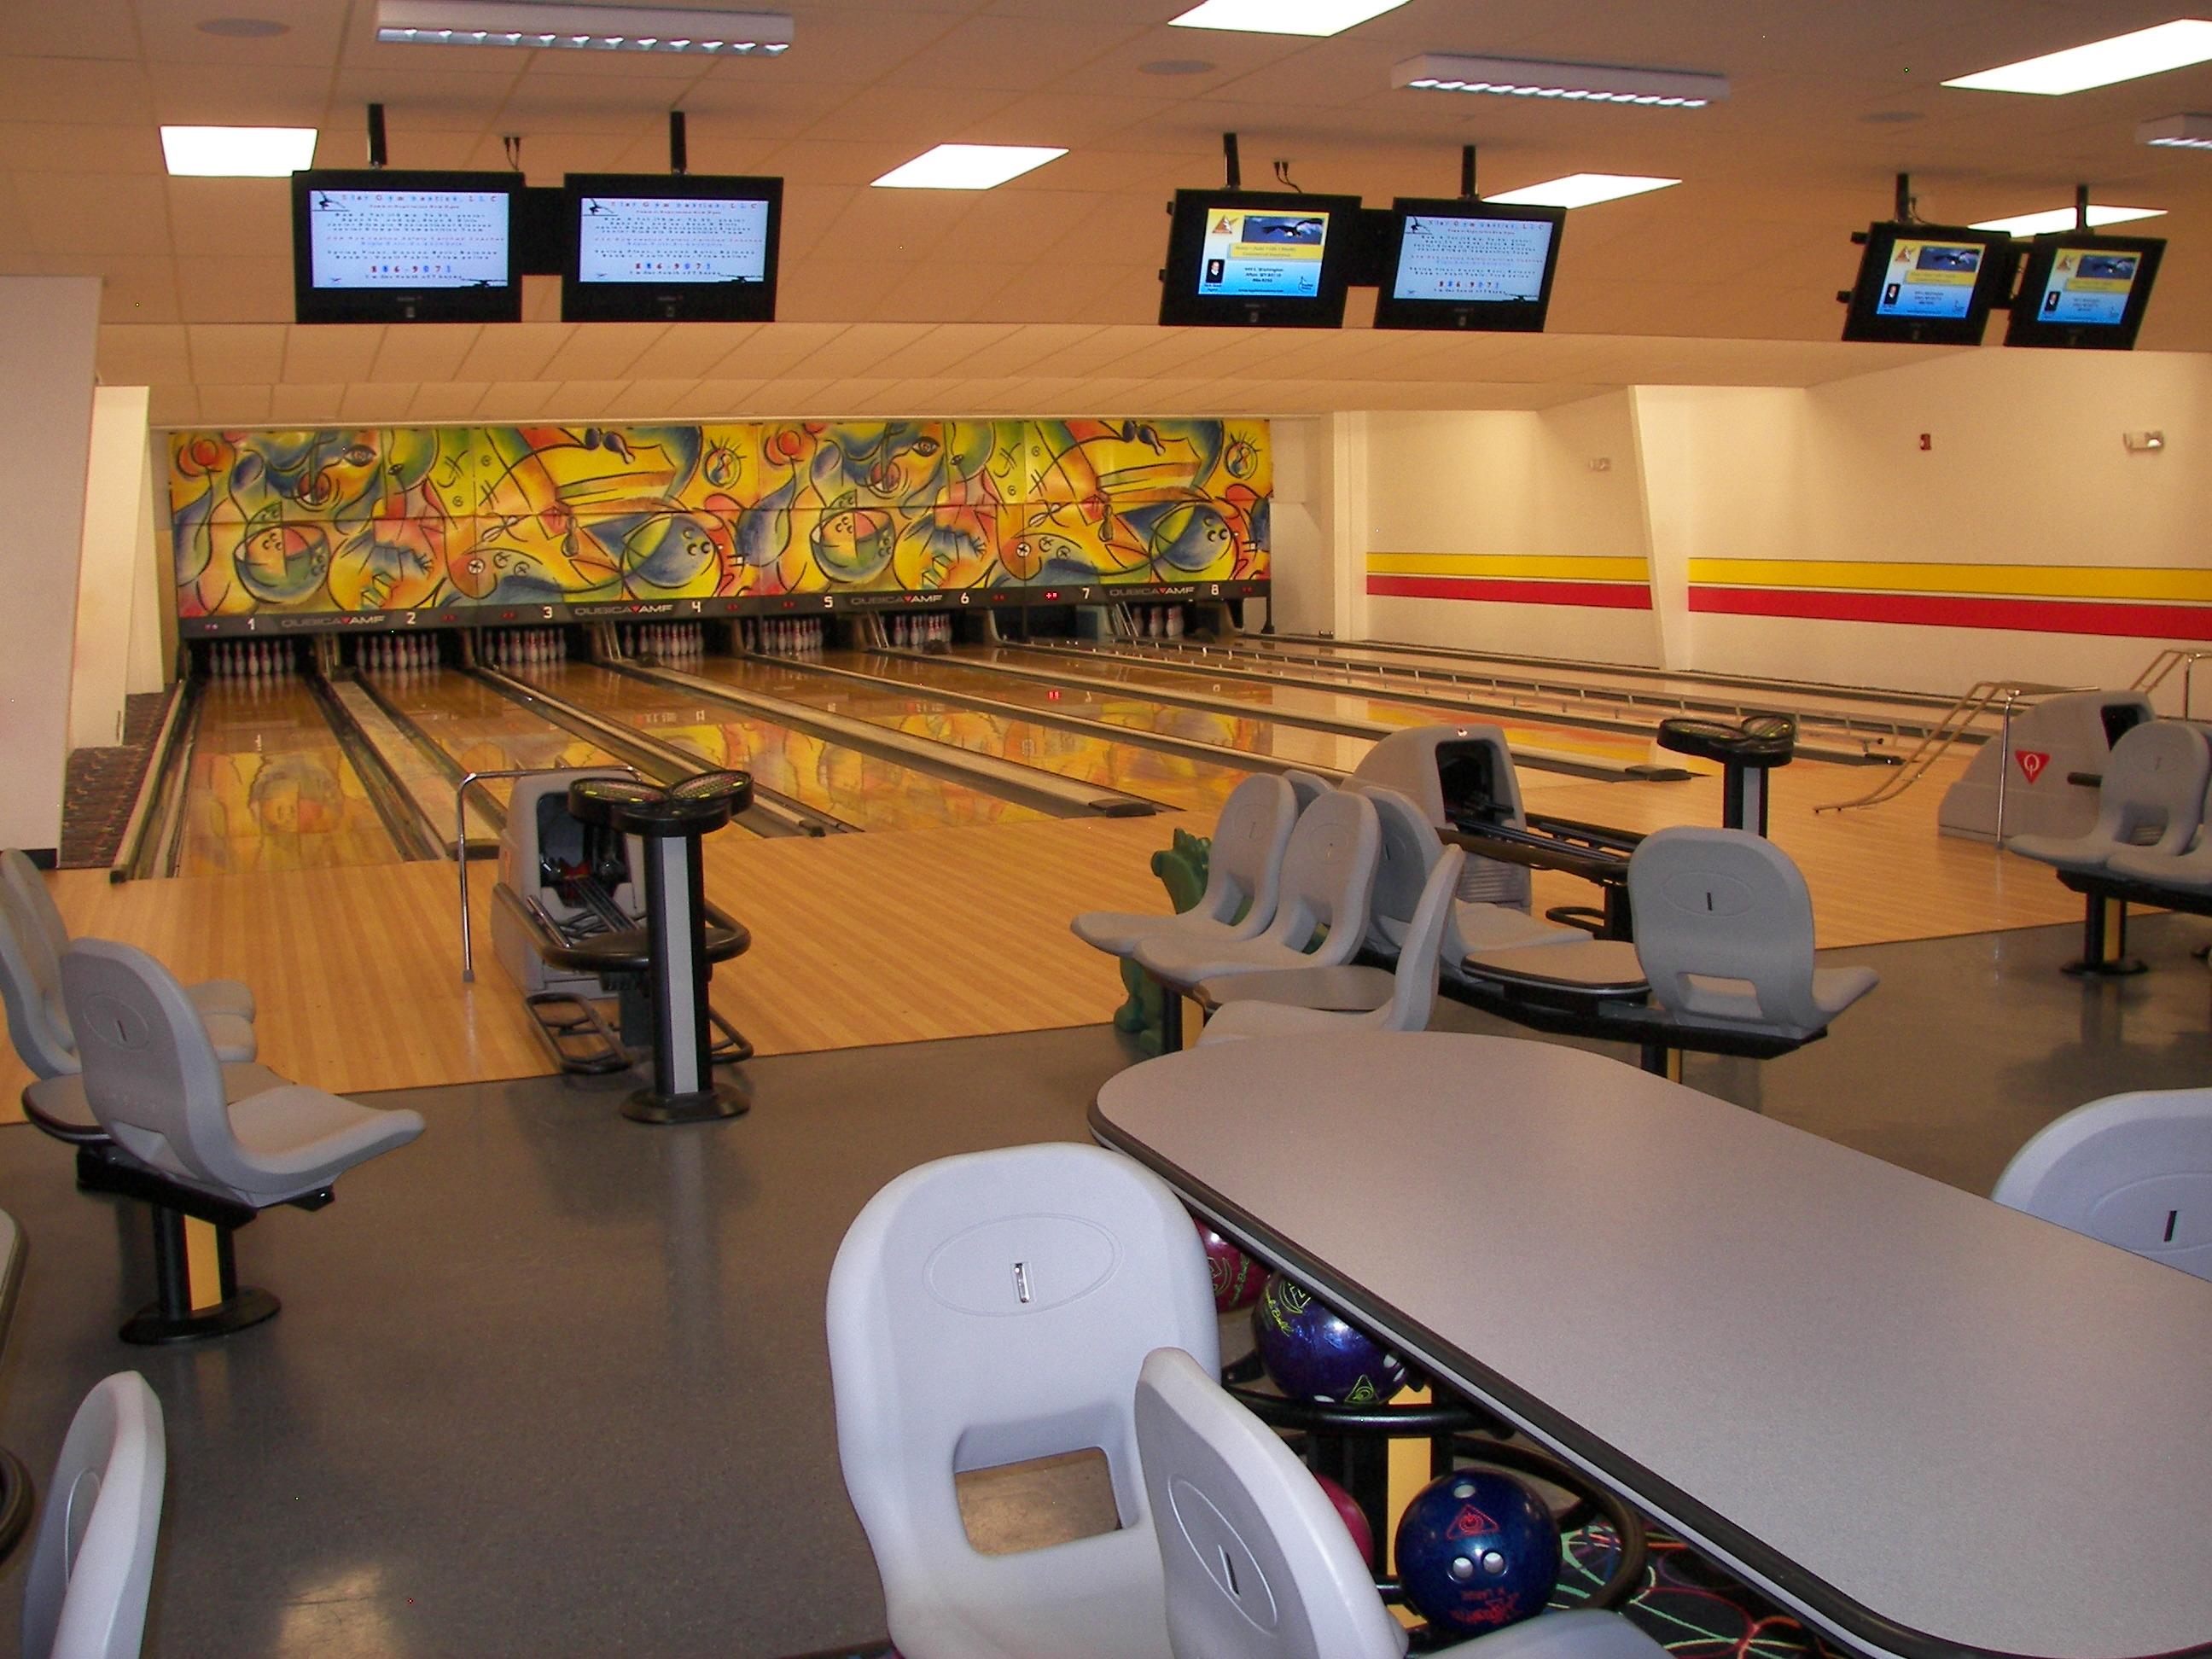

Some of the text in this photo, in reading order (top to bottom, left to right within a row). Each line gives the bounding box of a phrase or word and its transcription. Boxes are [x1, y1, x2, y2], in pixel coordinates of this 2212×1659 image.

[1082, 588, 1090, 599] 7
[1164, 586, 1195, 595] AMF
[1211, 585, 1220, 596] 8
[824, 596, 833, 608] 5
[911, 595, 943, 603] AMF
[960, 591, 969, 604] 6
[544, 606, 553, 619] 3
[638, 604, 673, 614] AMF
[692, 601, 701, 613] 4
[247, 618, 255, 631] 1
[349, 614, 386, 625] AMF
[406, 612, 416, 625] 2
[2023, 754, 2040, 780] Q
